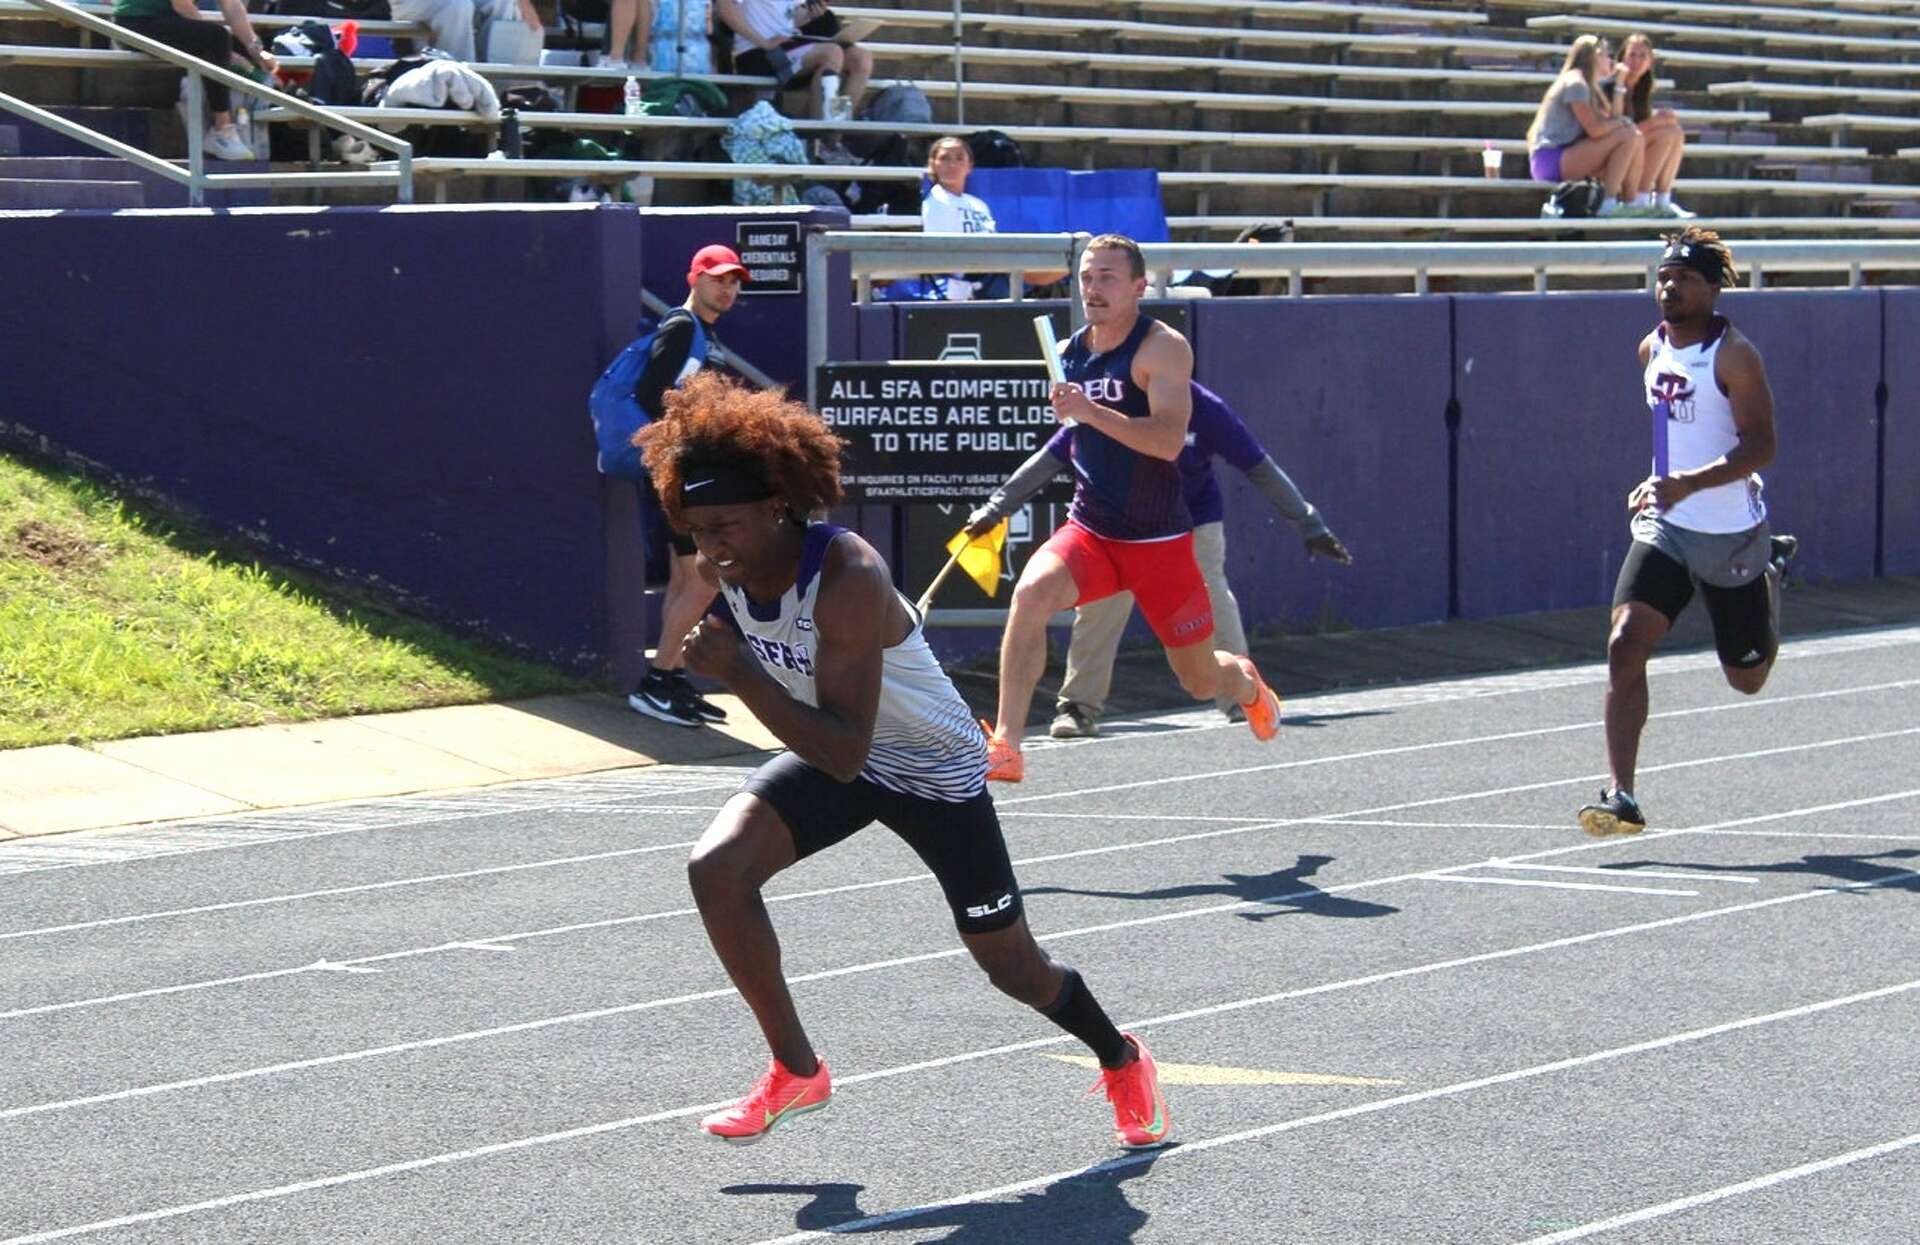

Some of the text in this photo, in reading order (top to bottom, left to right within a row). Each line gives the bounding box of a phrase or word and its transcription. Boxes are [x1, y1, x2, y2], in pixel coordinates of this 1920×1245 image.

[741, 251, 797, 264] CREDENTIALS
[830, 379, 1051, 399] ALL SFA COMPETITI
[821, 406, 1056, 425] SURFACES ARE CLOS
[871, 432, 1036, 451] TO THE PUBLIC
[857, 474, 904, 485] INQUIRIES
[907, 474, 920, 485] ON
[922, 474, 964, 484] FACILITY
[966, 474, 998, 484] USAGE
[966, 893, 1013, 918] SLC
